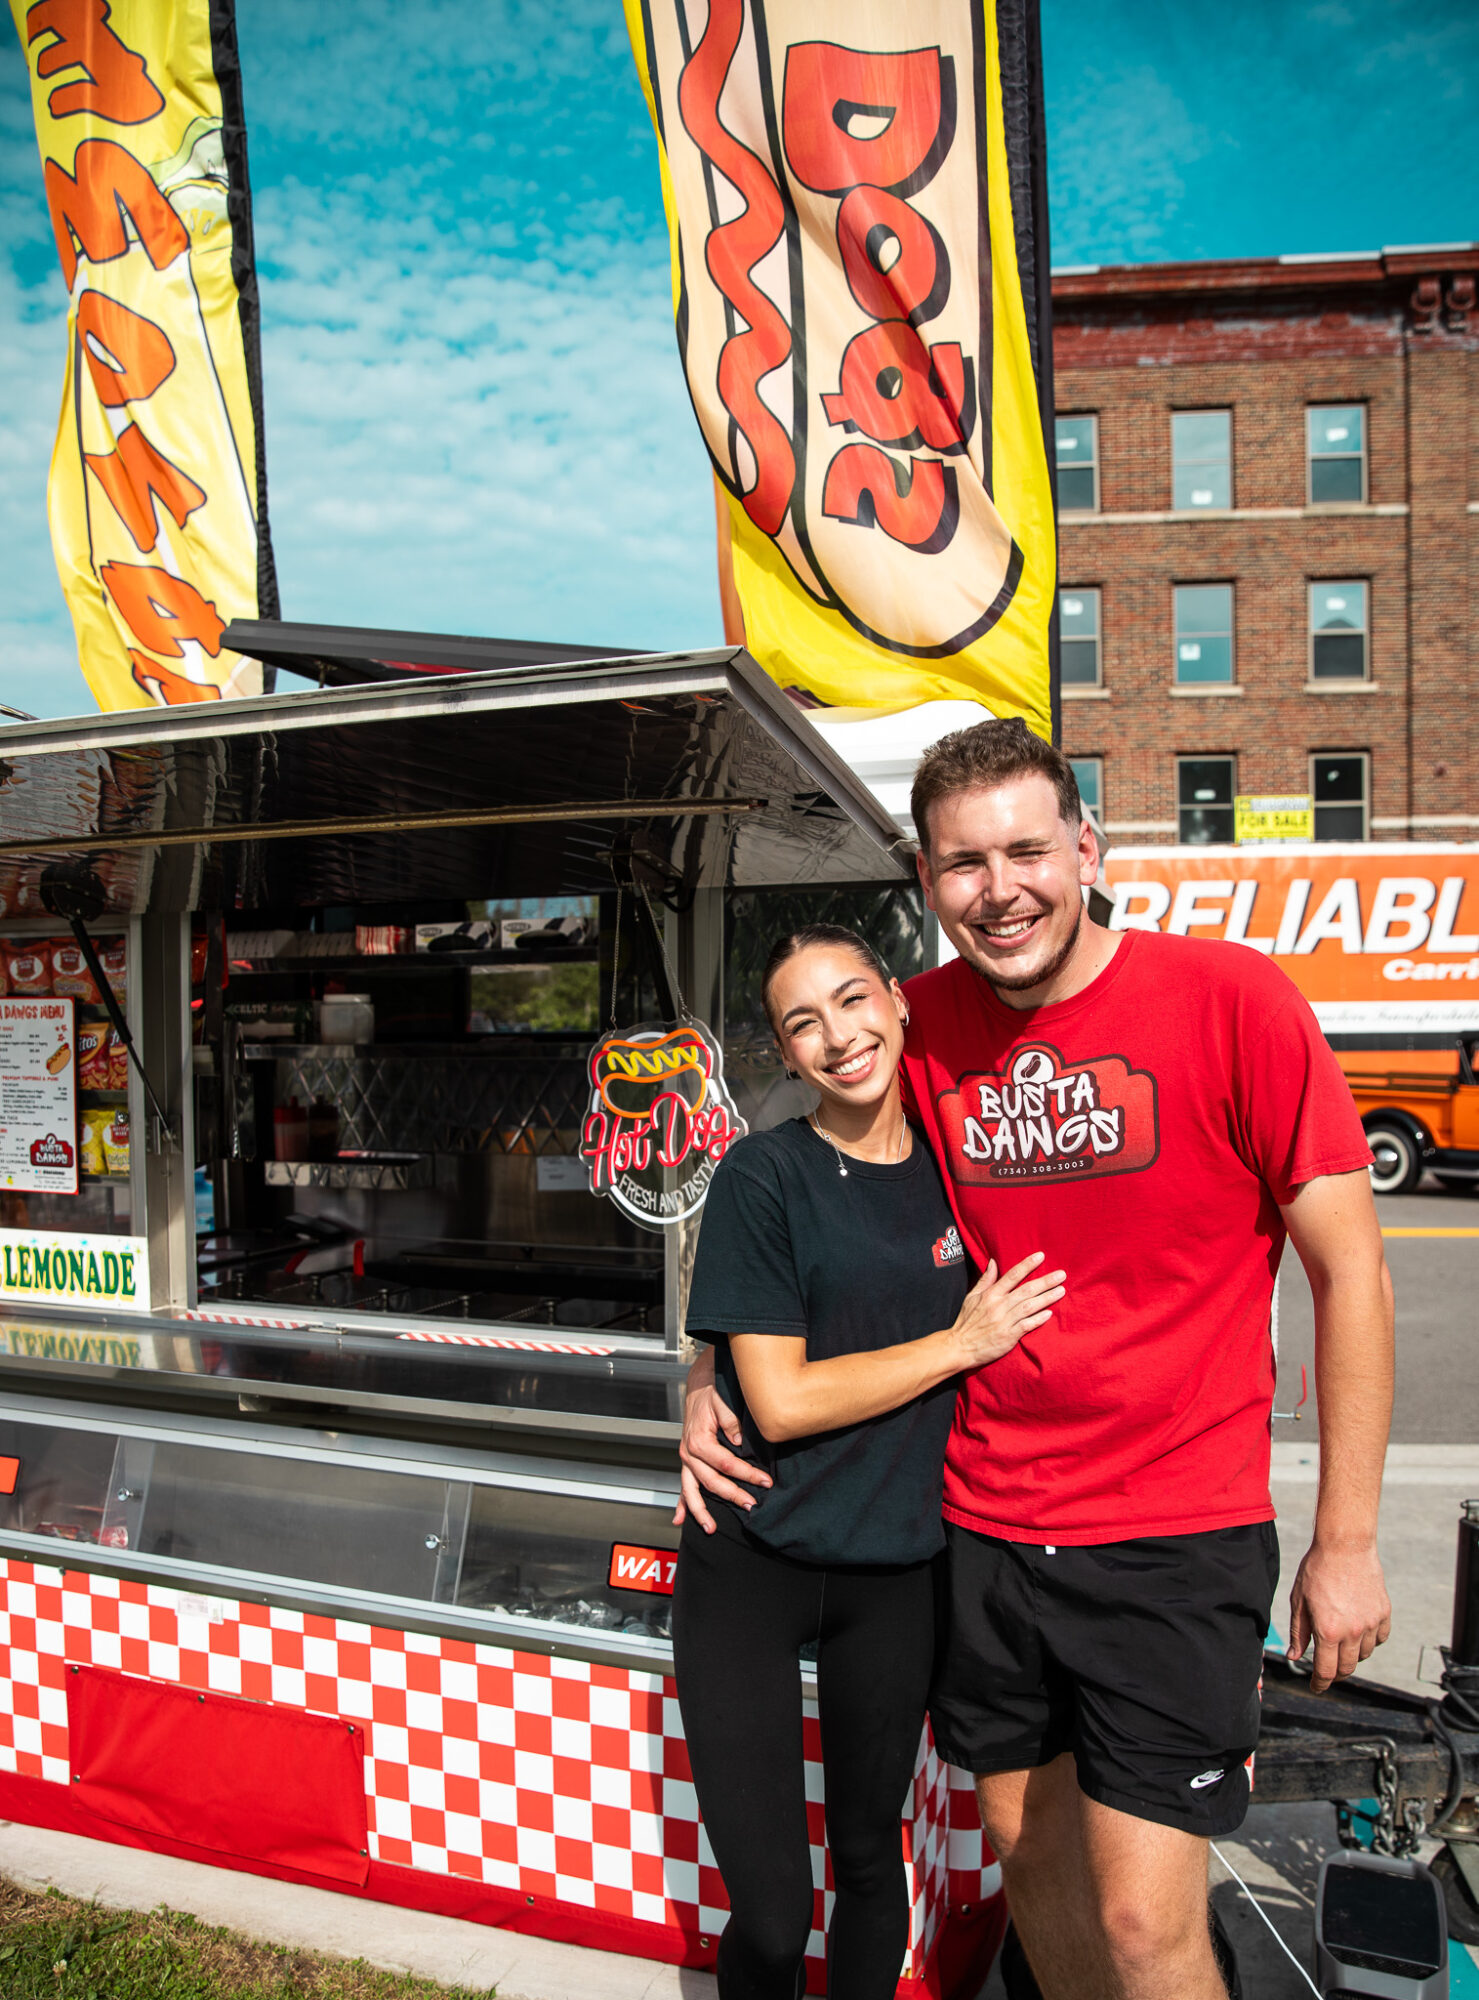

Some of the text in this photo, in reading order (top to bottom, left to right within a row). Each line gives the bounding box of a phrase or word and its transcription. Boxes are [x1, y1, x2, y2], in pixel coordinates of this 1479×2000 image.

[1274, 811, 1308, 827] SALE
[4, 1005, 38, 1019] DAWGS
[41, 1005, 65, 1019] MENU
[978, 1072, 1095, 1119] BUSTA
[583, 1091, 740, 1189] Hot Dog
[962, 1108, 1120, 1161] DAWGS
[36, 1152, 68, 1165] DAWGS
[998, 1160, 1085, 1176] (734) 308-3003
[618, 1154, 716, 1213] FRESH AND TASTY
[4, 1245, 137, 1298] LEMONADE
